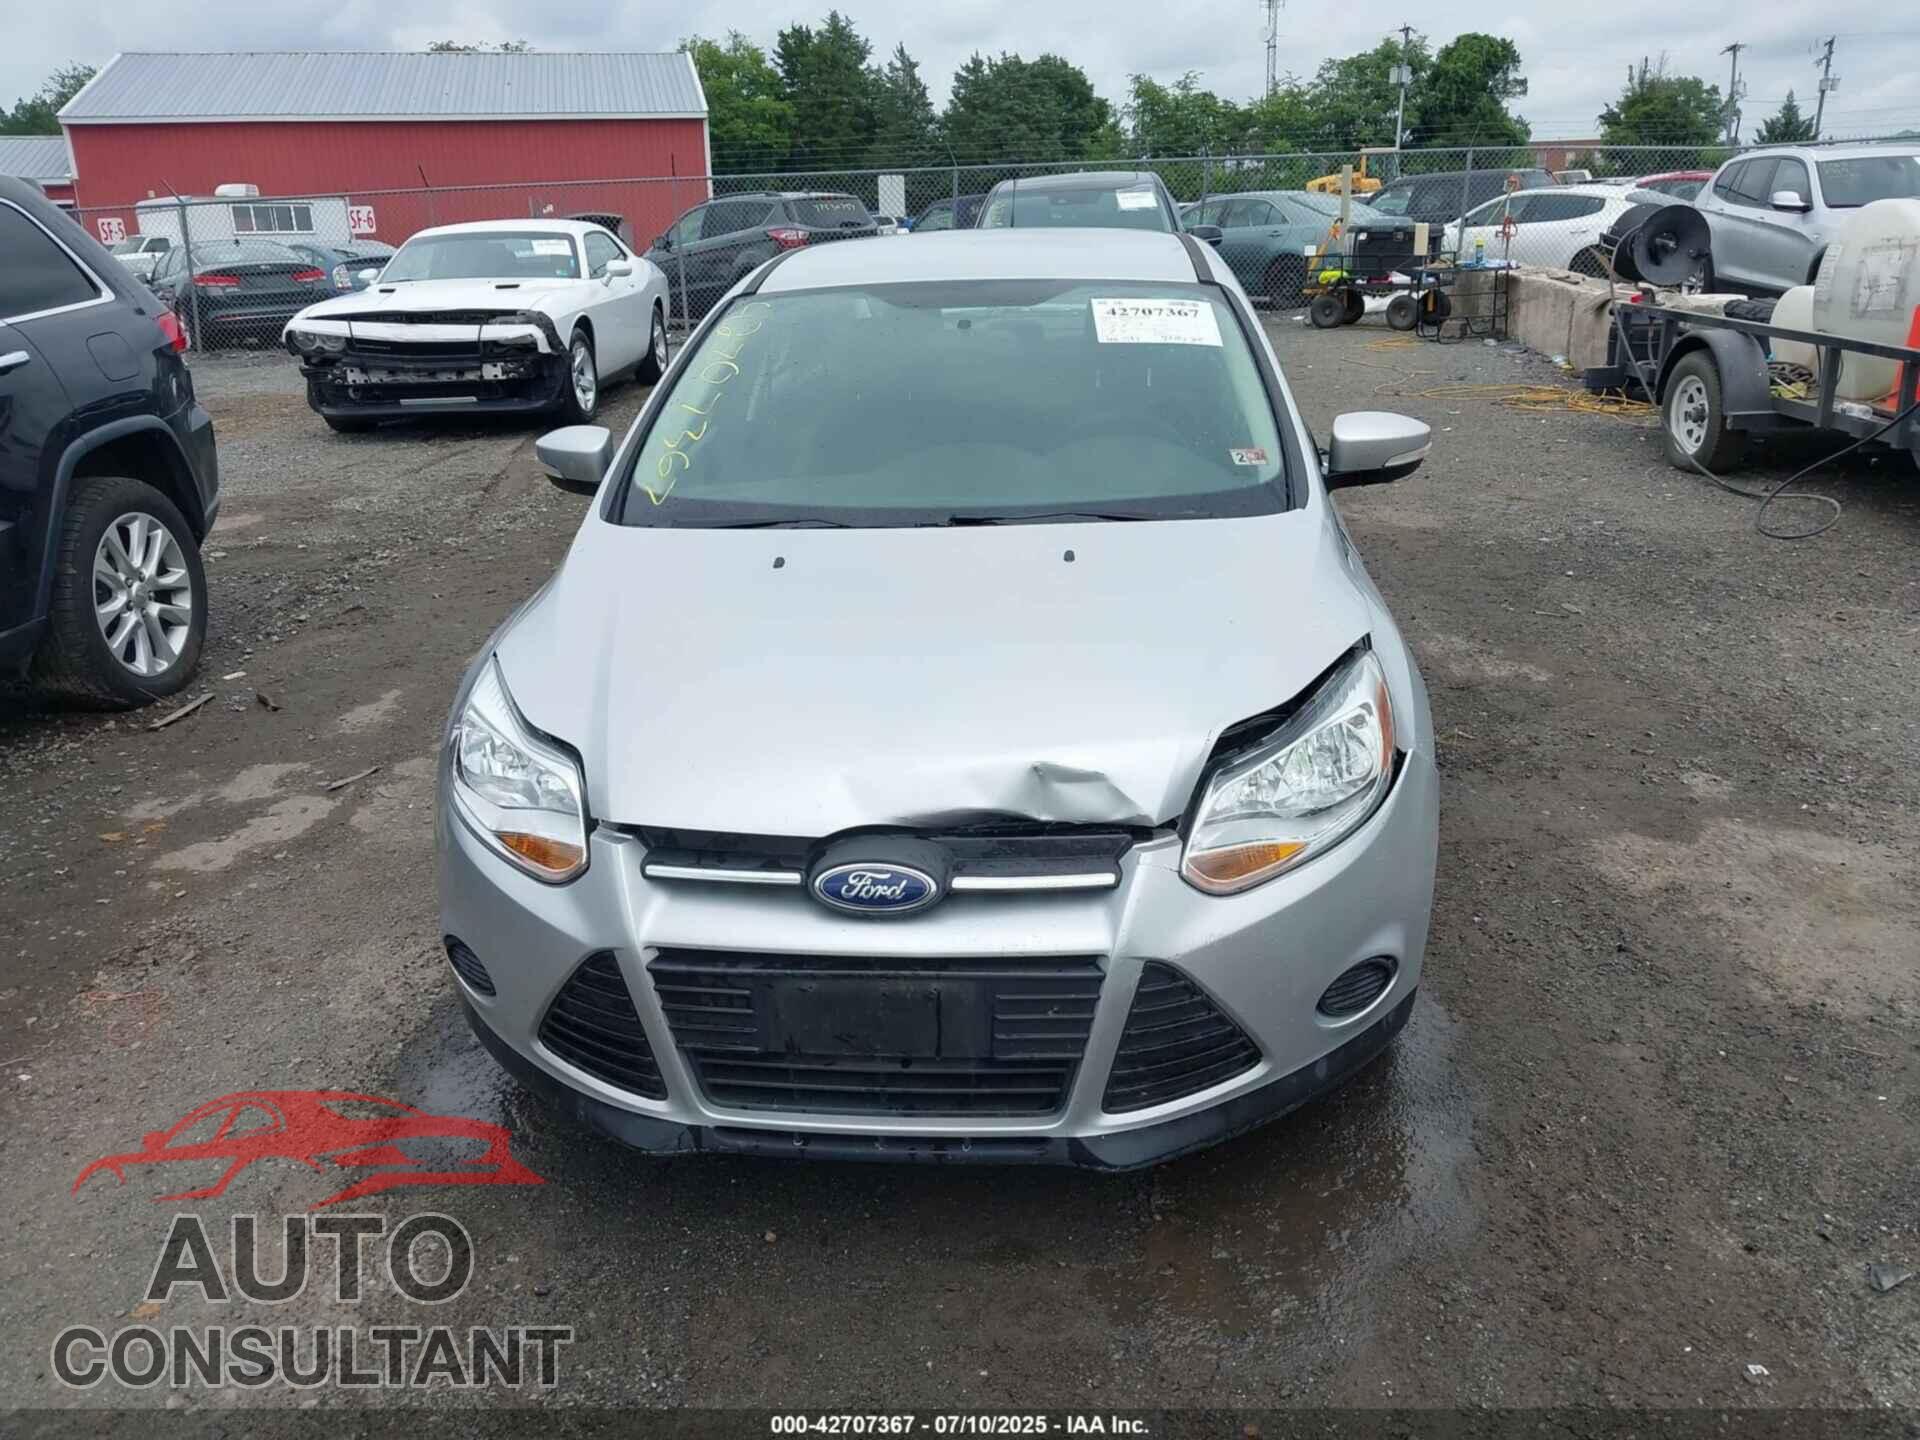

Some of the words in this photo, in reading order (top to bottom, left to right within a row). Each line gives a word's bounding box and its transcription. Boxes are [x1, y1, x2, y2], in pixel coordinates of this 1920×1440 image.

[350, 209, 375, 230] SF-6
[100, 221, 126, 242] SF-5
[1106, 306, 1199, 317] 42707367
[841, 870, 908, 900] Ford
